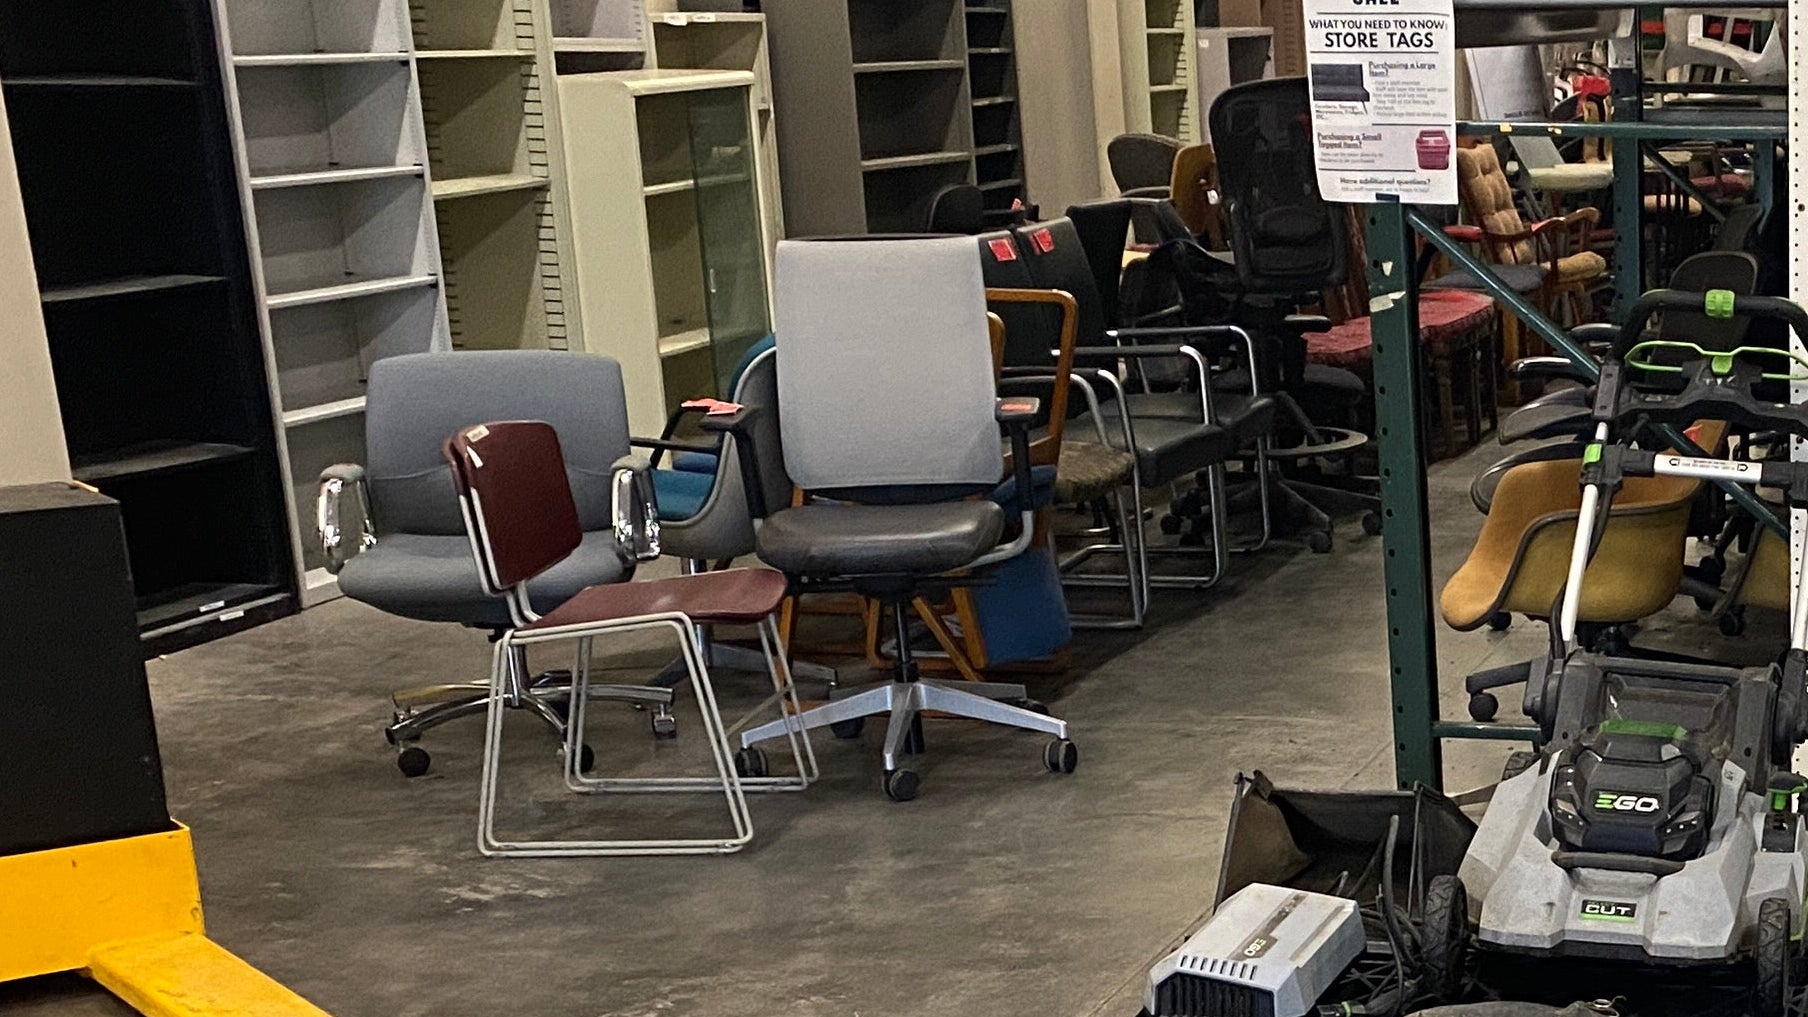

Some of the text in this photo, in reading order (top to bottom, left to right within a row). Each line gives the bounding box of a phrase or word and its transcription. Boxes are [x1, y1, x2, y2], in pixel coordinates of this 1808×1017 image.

[1309, 19, 1339, 29] WHAT
[1341, 19, 1362, 29] YOU
[1364, 19, 1391, 29] NEED
[1393, 19, 1407, 29] TO
[1324, 31, 1434, 48] STORE TAGS
[1594, 793, 1660, 812] EGO
[1585, 904, 1632, 916] CUT
[1243, 938, 1266, 957] EGO
